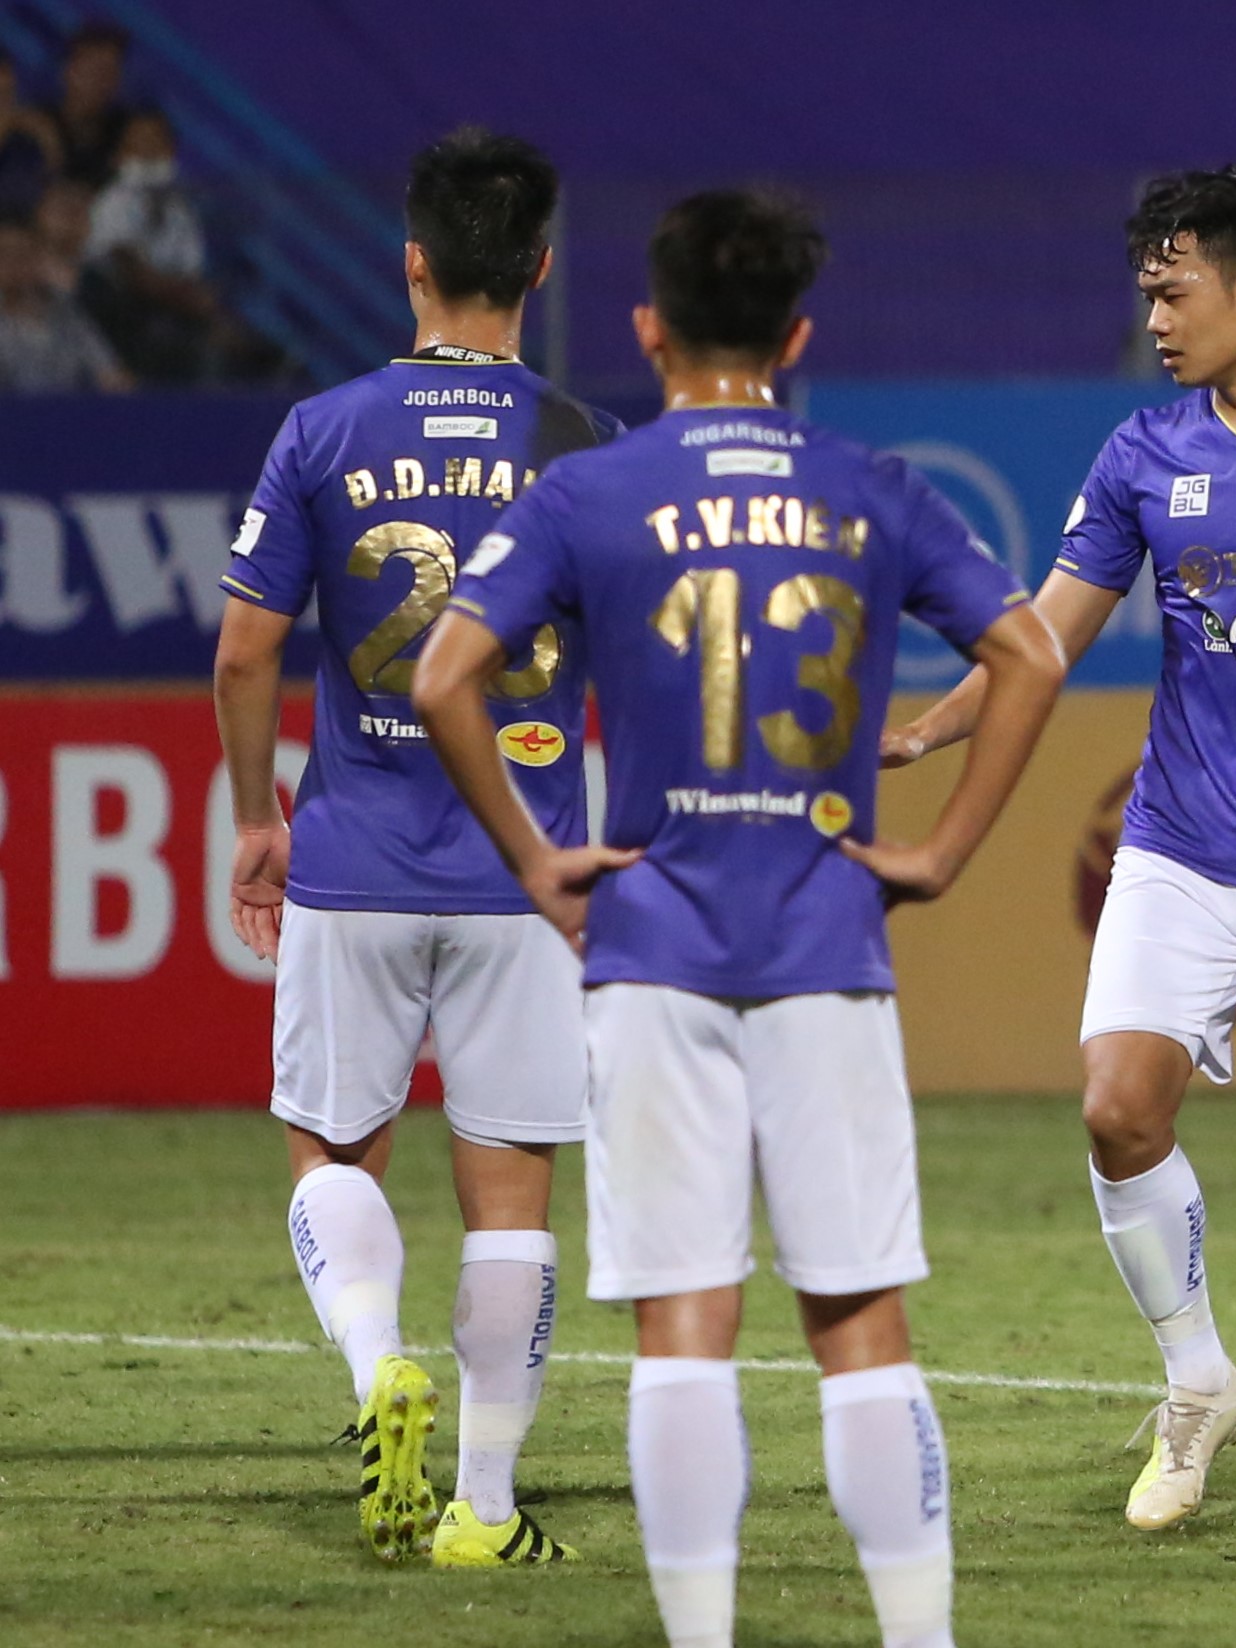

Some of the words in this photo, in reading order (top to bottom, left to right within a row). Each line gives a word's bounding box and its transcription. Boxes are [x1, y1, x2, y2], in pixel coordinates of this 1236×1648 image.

[434, 346, 467, 360] NIKE
[465, 351, 494, 363] PRO
[403, 389, 514, 408] JOGARBOLA
[680, 422, 806, 447] JOGARBOLA
[1175, 479, 1206, 496] JG
[1173, 498, 1203, 514] BL
[648, 568, 865, 773] 13
